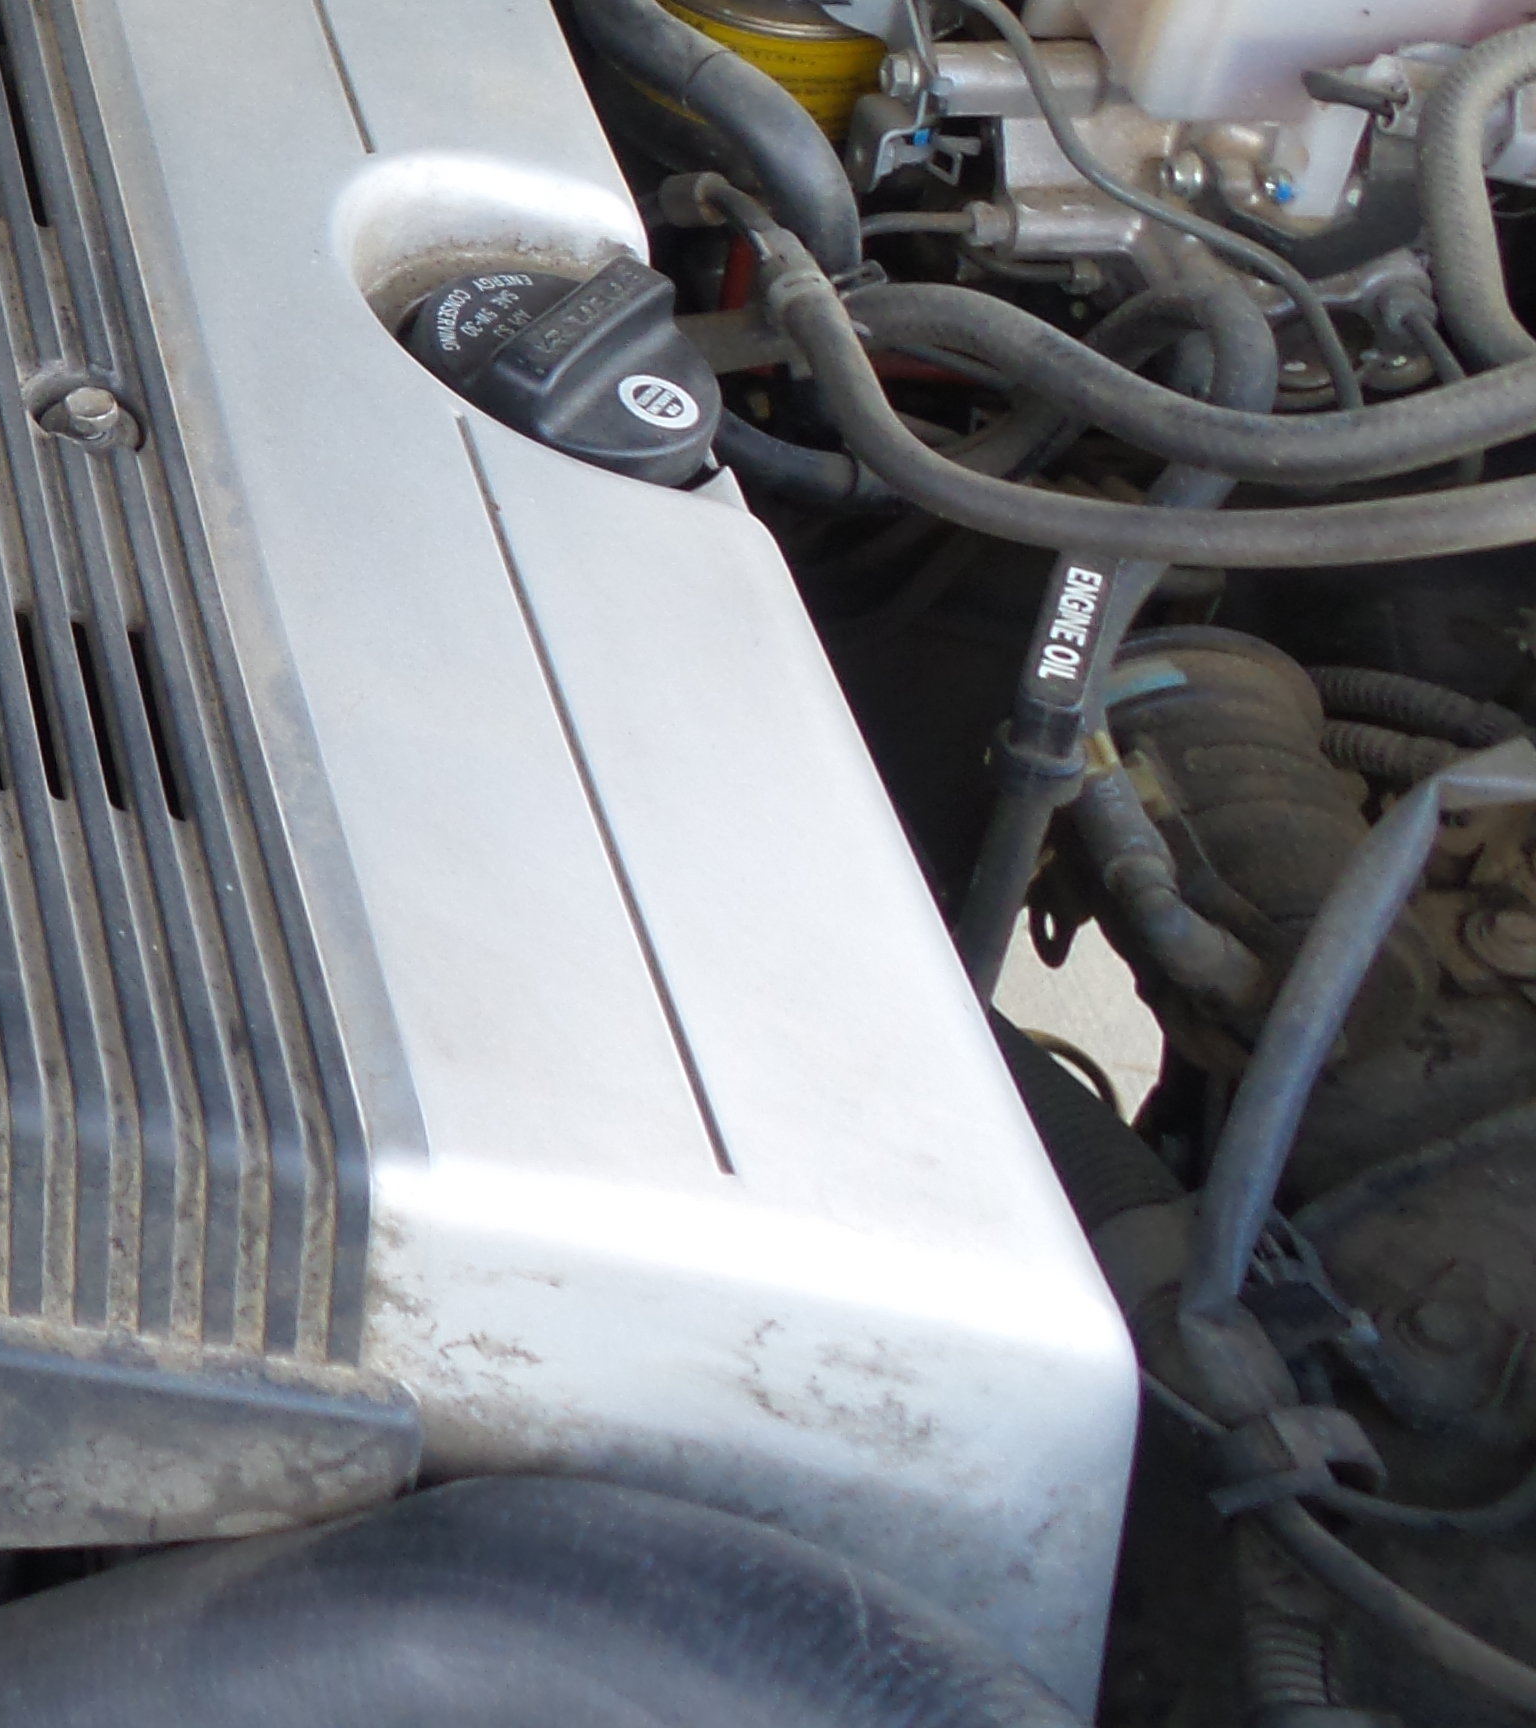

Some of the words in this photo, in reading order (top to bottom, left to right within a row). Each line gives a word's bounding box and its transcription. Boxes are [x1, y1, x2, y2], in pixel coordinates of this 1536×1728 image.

[472, 273, 534, 292] ENERGY
[490, 289, 521, 309] SAE
[436, 288, 472, 352] CONSERVING
[460, 308, 499, 338] 5W-30
[1049, 566, 1103, 647] ENGINE
[1037, 643, 1081, 680] OIL
